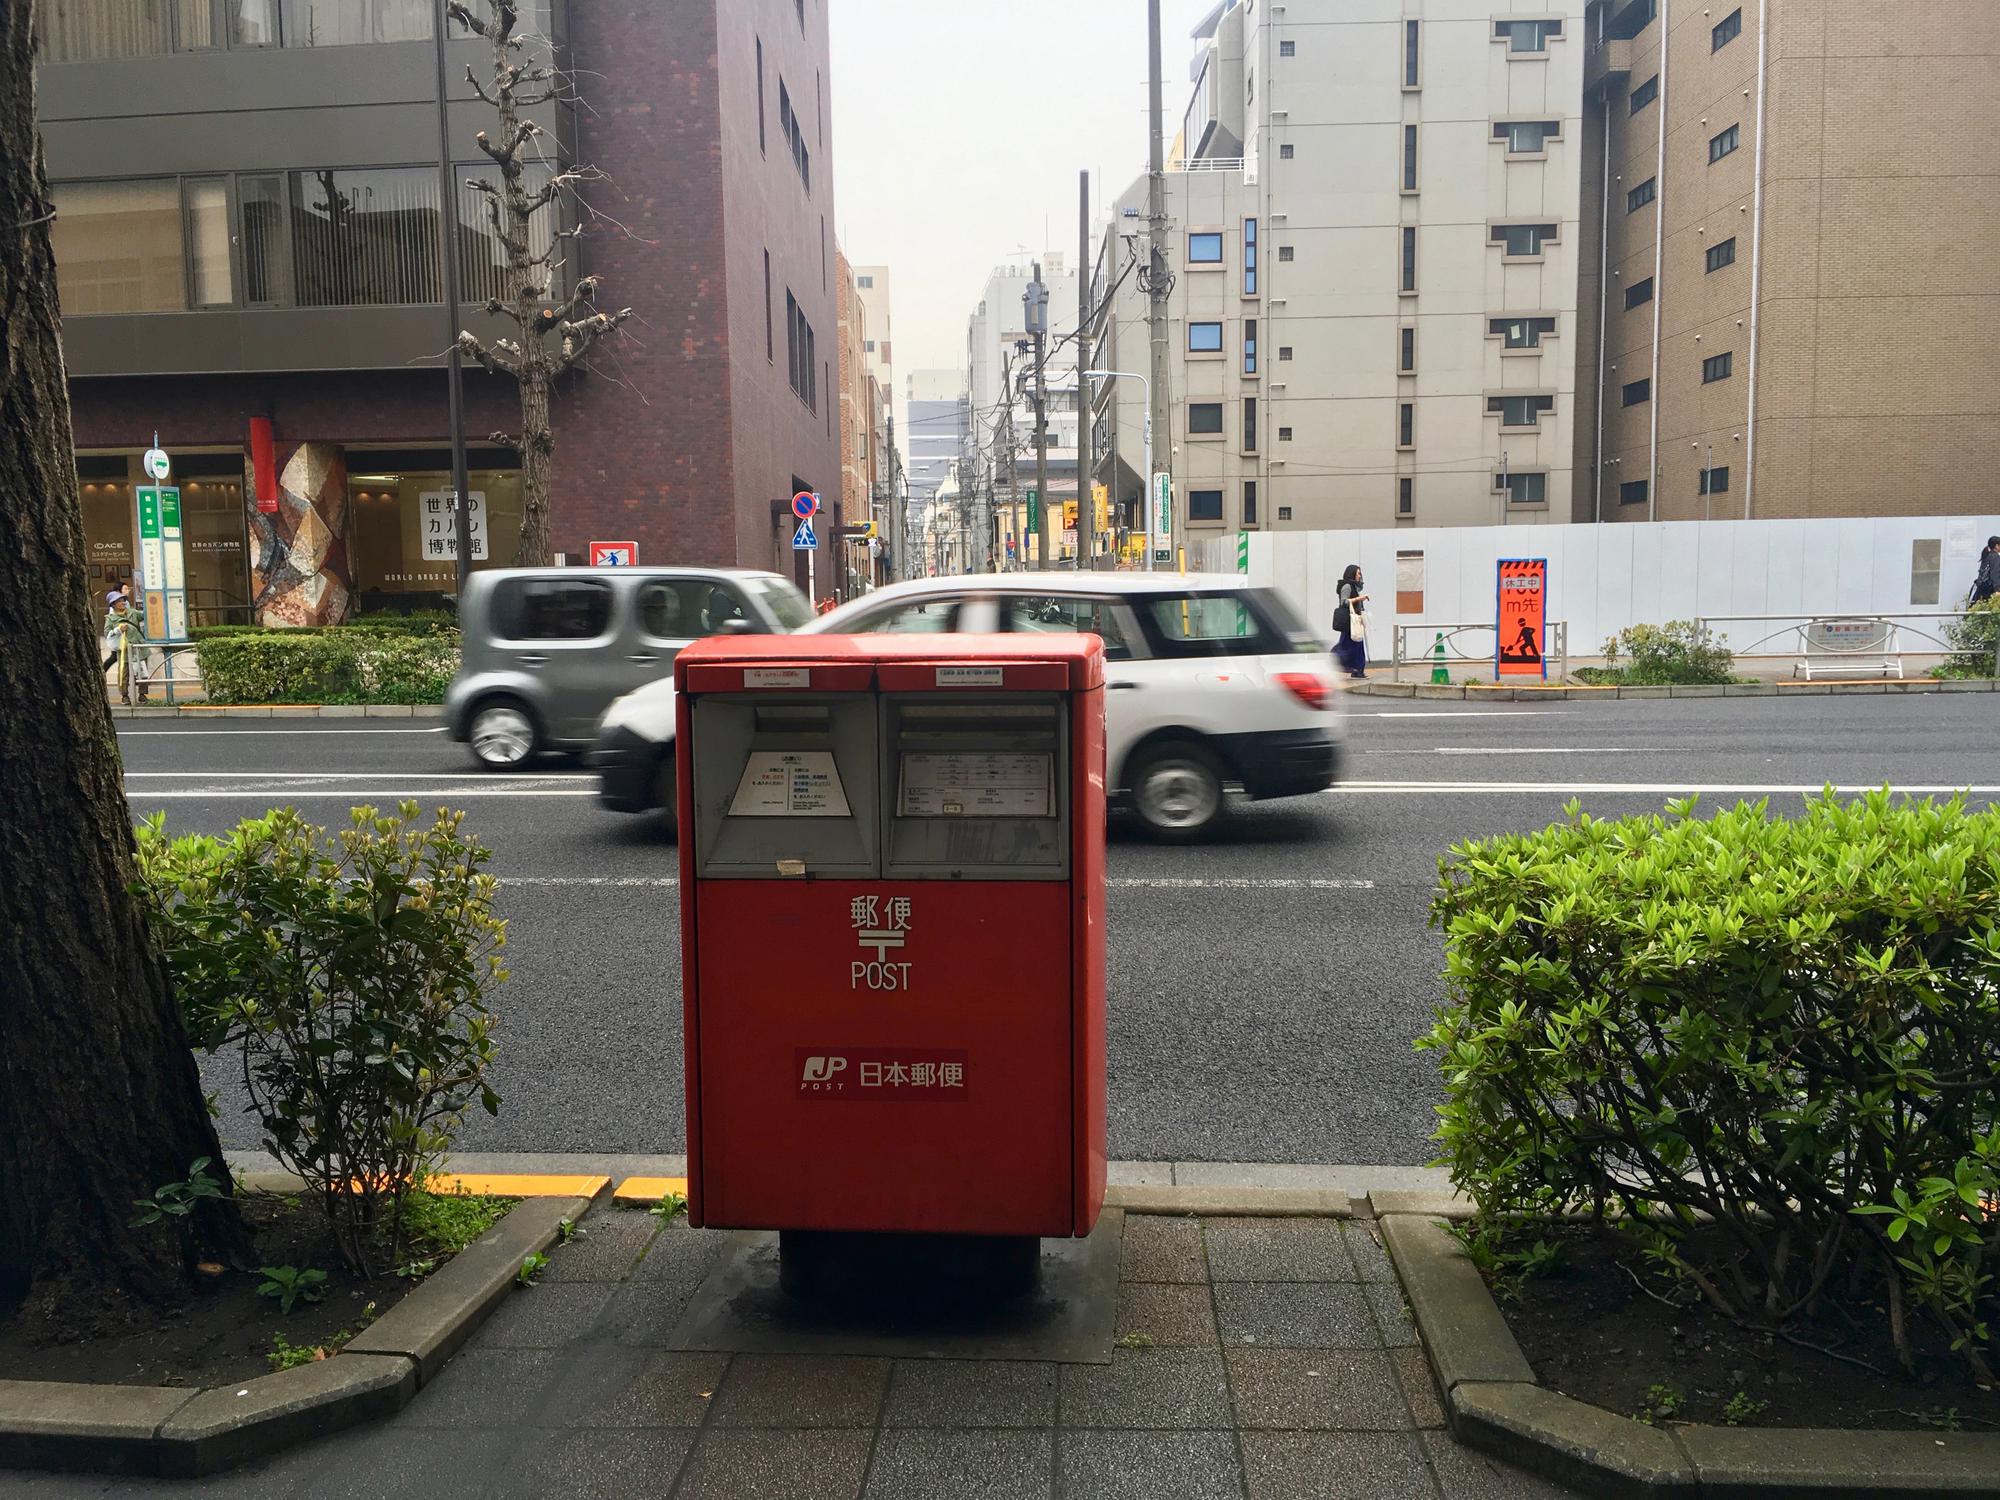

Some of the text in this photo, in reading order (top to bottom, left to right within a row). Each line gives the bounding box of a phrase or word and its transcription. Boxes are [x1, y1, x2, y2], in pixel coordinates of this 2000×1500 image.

[1505, 579, 1537, 588] 休工中
[1506, 598, 1539, 613] m先
[850, 895, 912, 930] 郵便
[851, 961, 912, 990] POST
[802, 1056, 848, 1081] JP
[860, 1061, 964, 1088] 日本郵便
[800, 1083, 844, 1091] POST
